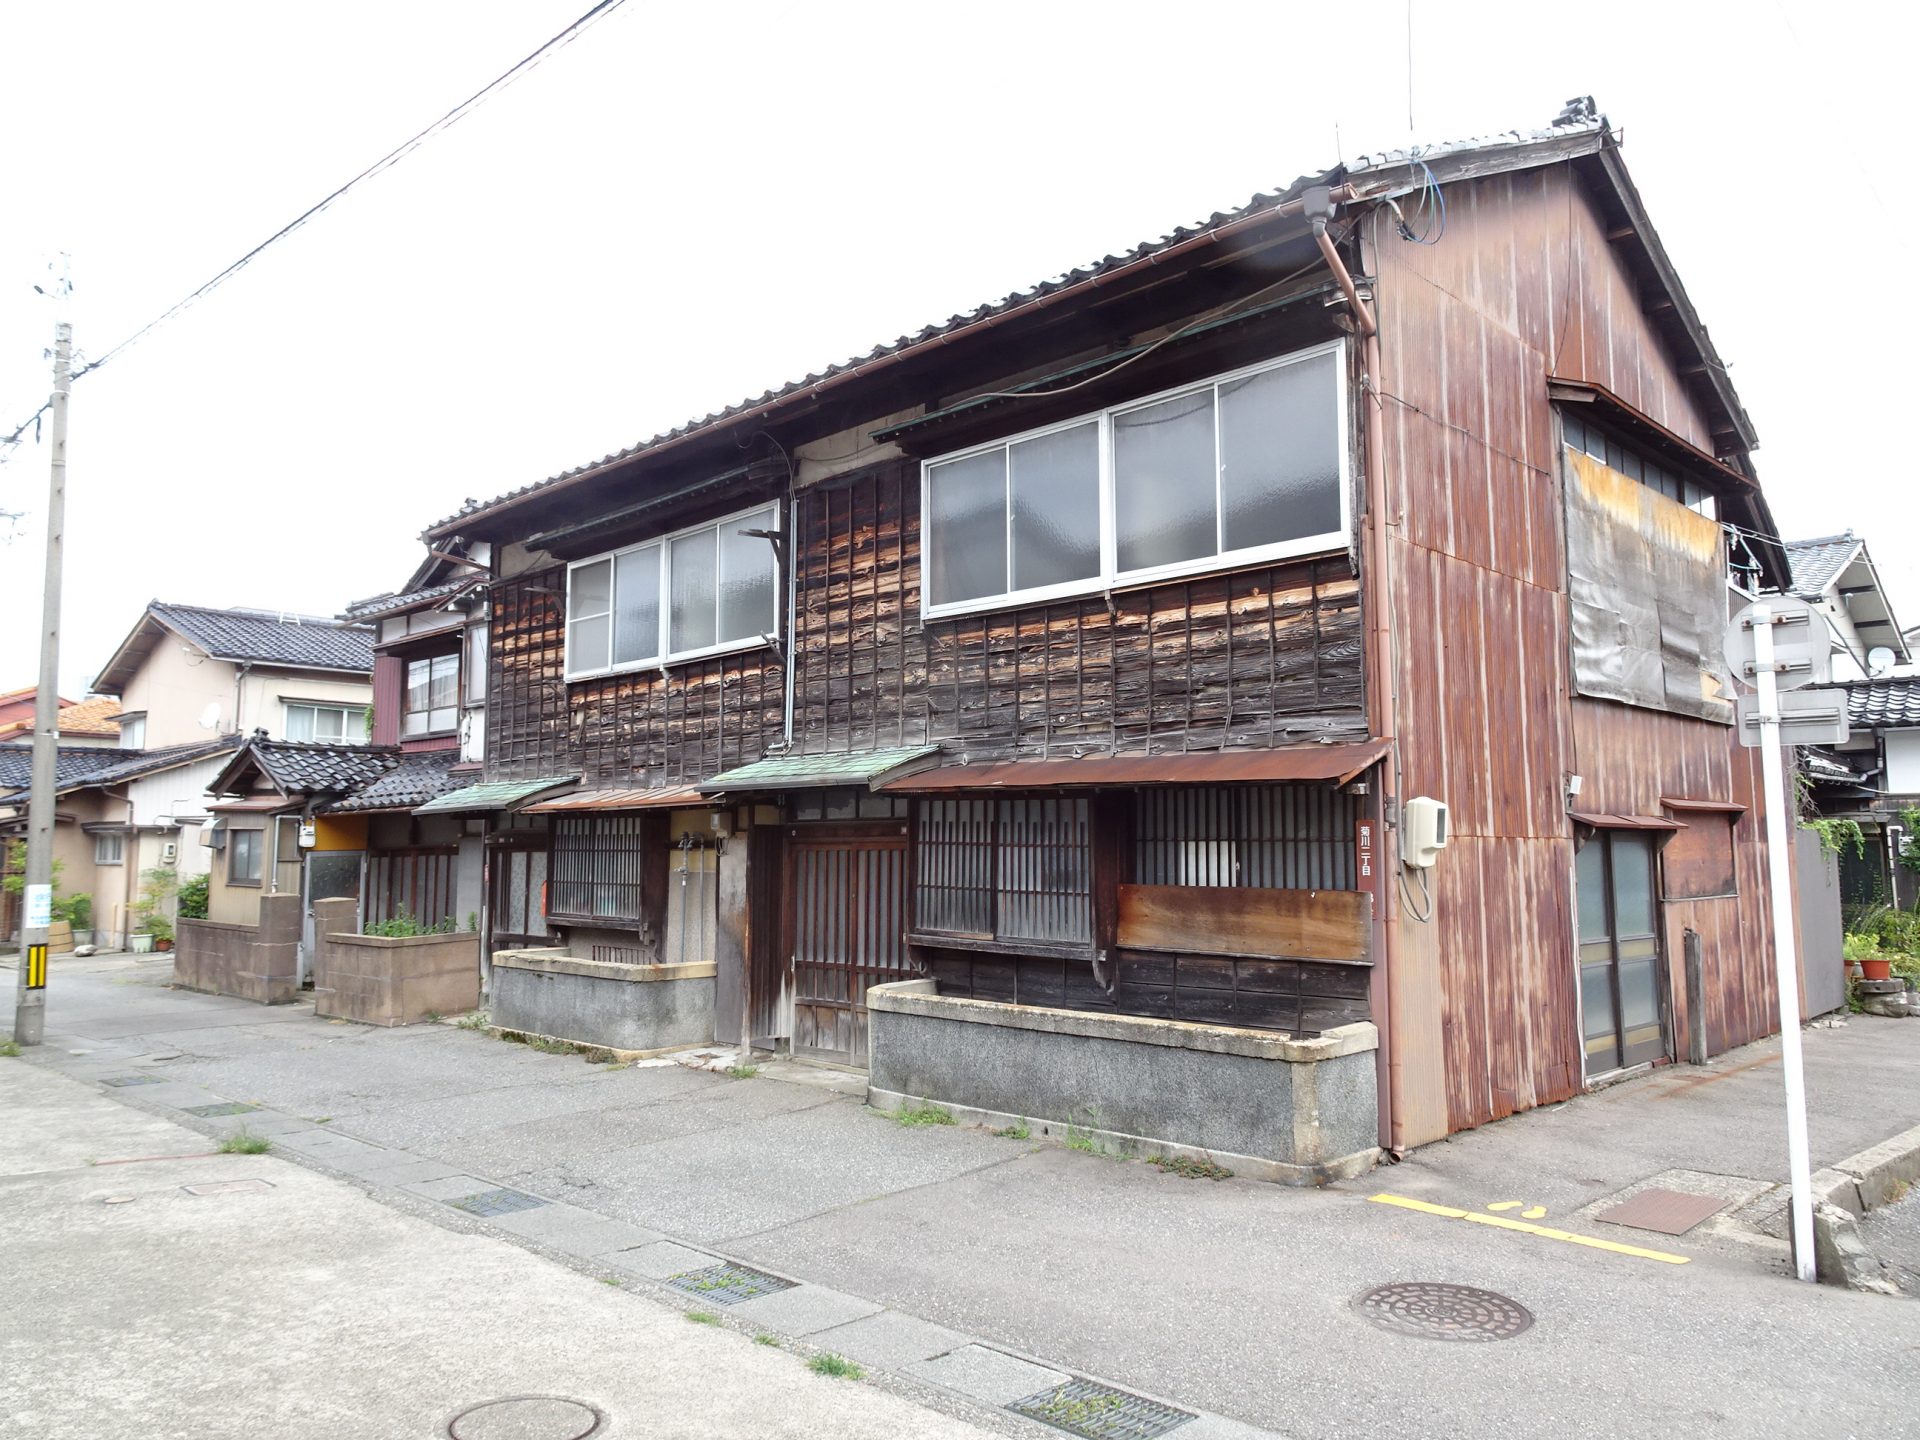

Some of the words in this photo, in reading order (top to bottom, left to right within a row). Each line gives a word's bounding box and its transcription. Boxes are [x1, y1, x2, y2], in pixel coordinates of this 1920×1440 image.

[1360, 826, 1371, 876] 菊川二丁目
